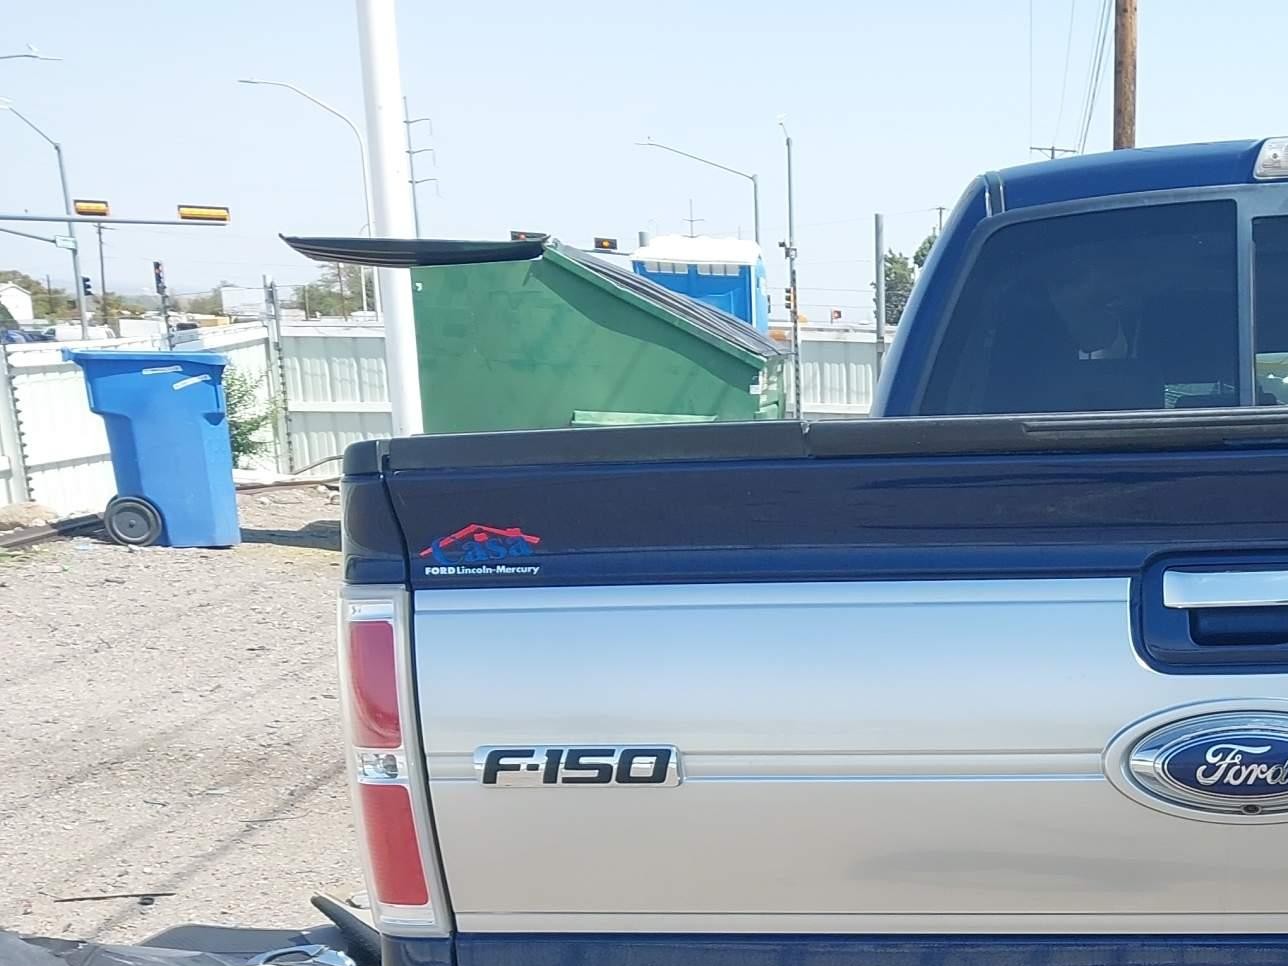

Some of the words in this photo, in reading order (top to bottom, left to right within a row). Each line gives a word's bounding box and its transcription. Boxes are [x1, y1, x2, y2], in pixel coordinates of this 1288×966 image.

[431, 537, 534, 565] Casa
[424, 566, 456, 576] FORD
[456, 565, 541, 576] Lincoln-Mercury
[482, 749, 672, 785] F-150
